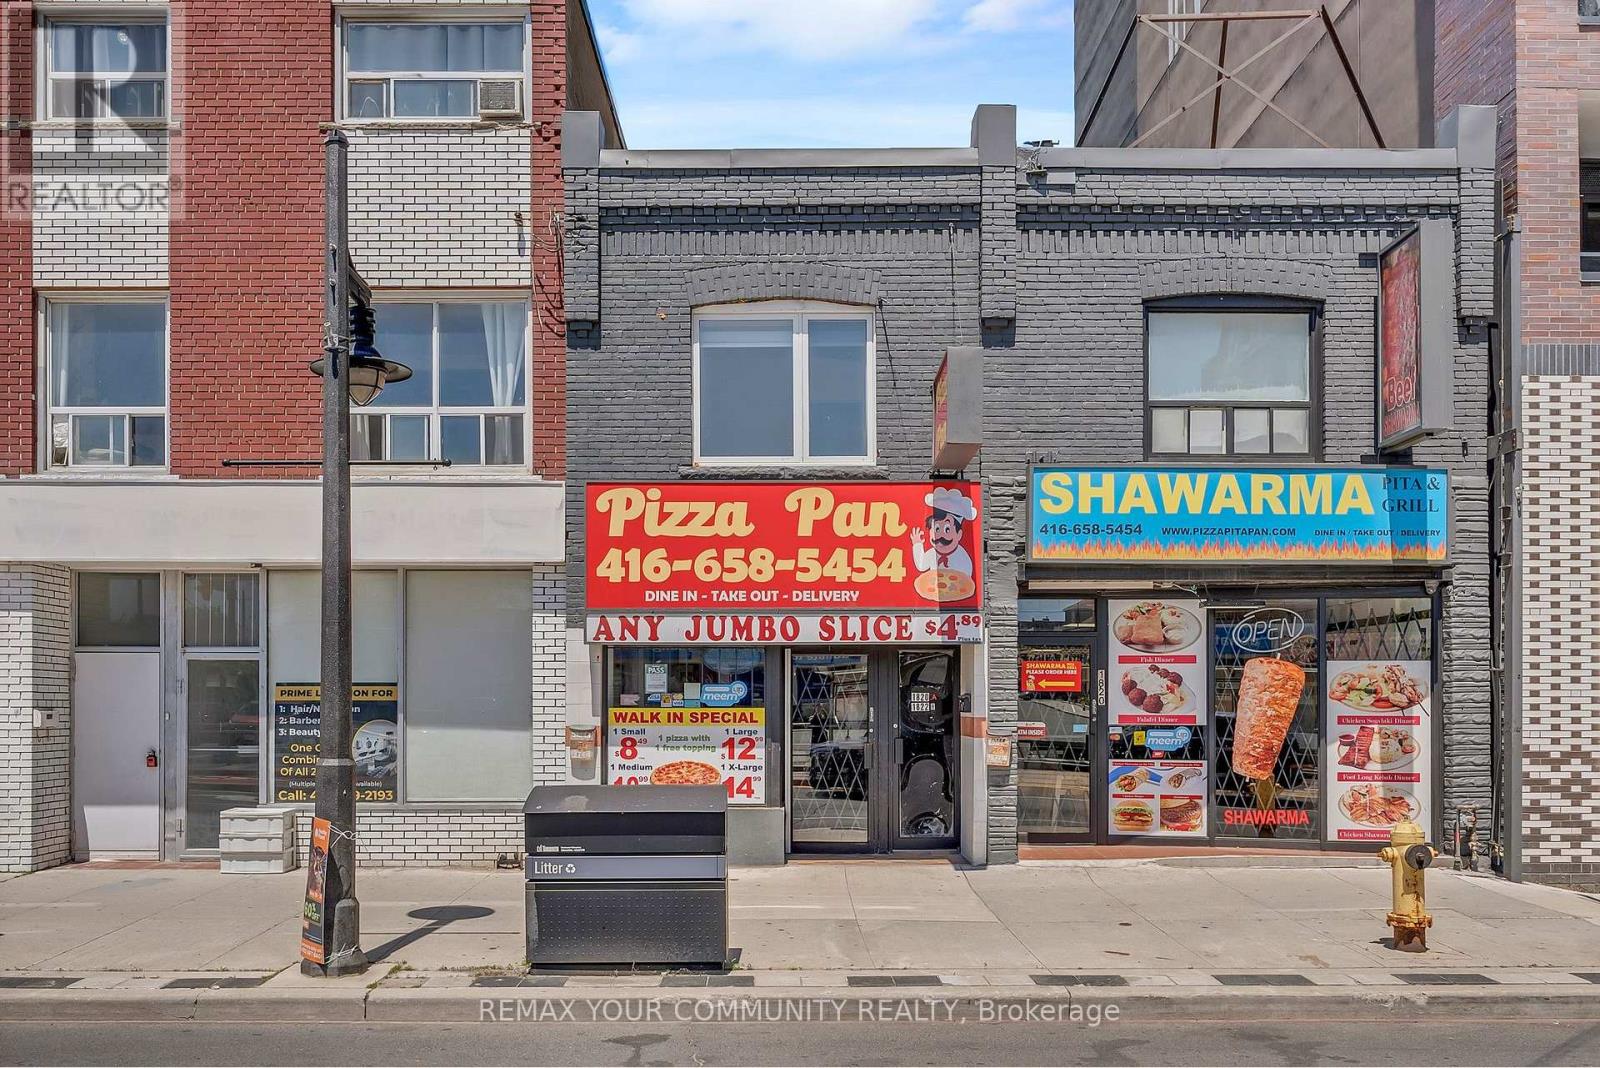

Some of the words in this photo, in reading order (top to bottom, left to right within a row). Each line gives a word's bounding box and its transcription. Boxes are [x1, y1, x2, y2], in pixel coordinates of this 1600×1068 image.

[1387, 365, 1416, 411] Beef
[1382, 476, 1422, 490] PITA
[1427, 477, 1440, 490] &
[1040, 472, 1375, 514] SHAWARMA
[596, 487, 755, 537] Pizza
[785, 487, 907, 537] Pan
[1382, 499, 1439, 513] GRILL
[1040, 523, 1143, 535] 416-658-5454
[1161, 527, 1296, 536] WWW.PIZZAPITAPAN.COM
[596, 548, 906, 583] 416-658-5454
[645, 590, 680, 602] DINE
[682, 590, 699, 602] IN
[711, 590, 748, 602] TAKE
[751, 590, 780, 602] OUT
[792, 590, 860, 602] DELIVERY
[593, 615, 665, 641] ANY
[685, 615, 799, 642] JUMBO
[818, 615, 913, 641] SLICE
[1237, 616, 1297, 643] OPEN
[279, 705, 286, 713] 1:
[290, 704, 321, 714] Hair/N
[613, 712, 662, 723] WALK
[667, 712, 684, 723] IN
[689, 712, 759, 723] SPECIAL
[279, 728, 287, 736] 3:
[289, 728, 320, 737] Beauty
[732, 728, 758, 736] Large
[665, 734, 689, 743] pizza
[691, 734, 711, 742] with
[290, 744, 313, 752] One
[682, 744, 717, 753] topping
[280, 767, 293, 776] Of
[295, 767, 308, 776] All
[728, 764, 763, 772] X-Large
[278, 790, 307, 800] Call:
[1224, 809, 1309, 825] SHAWARMA
[535, 861, 563, 874] Litter
